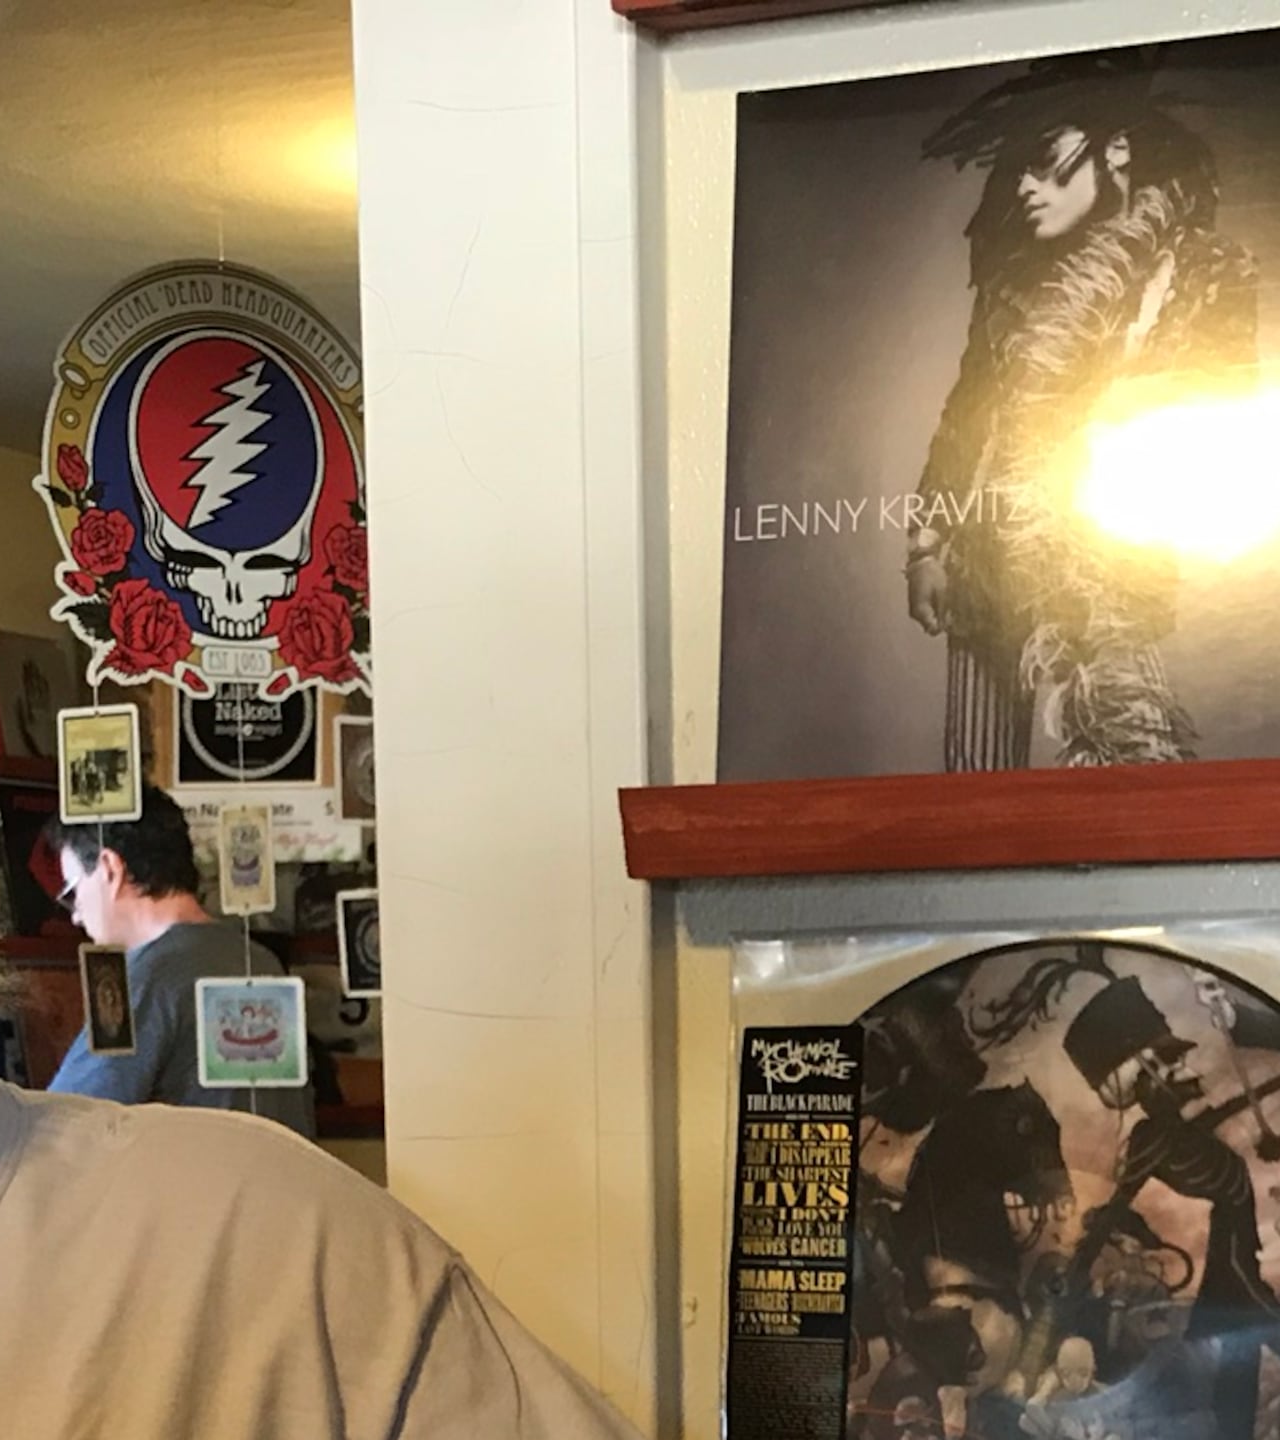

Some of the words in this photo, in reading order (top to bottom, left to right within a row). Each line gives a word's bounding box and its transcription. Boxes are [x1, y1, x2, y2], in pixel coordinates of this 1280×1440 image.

[89, 291, 159, 358] OFFICIAL
[733, 497, 868, 542] LENNY
[880, 487, 1026, 530] KRAVITZ
[742, 1182, 850, 1207] LIVES
[799, 1271, 847, 1292] SLEEP
